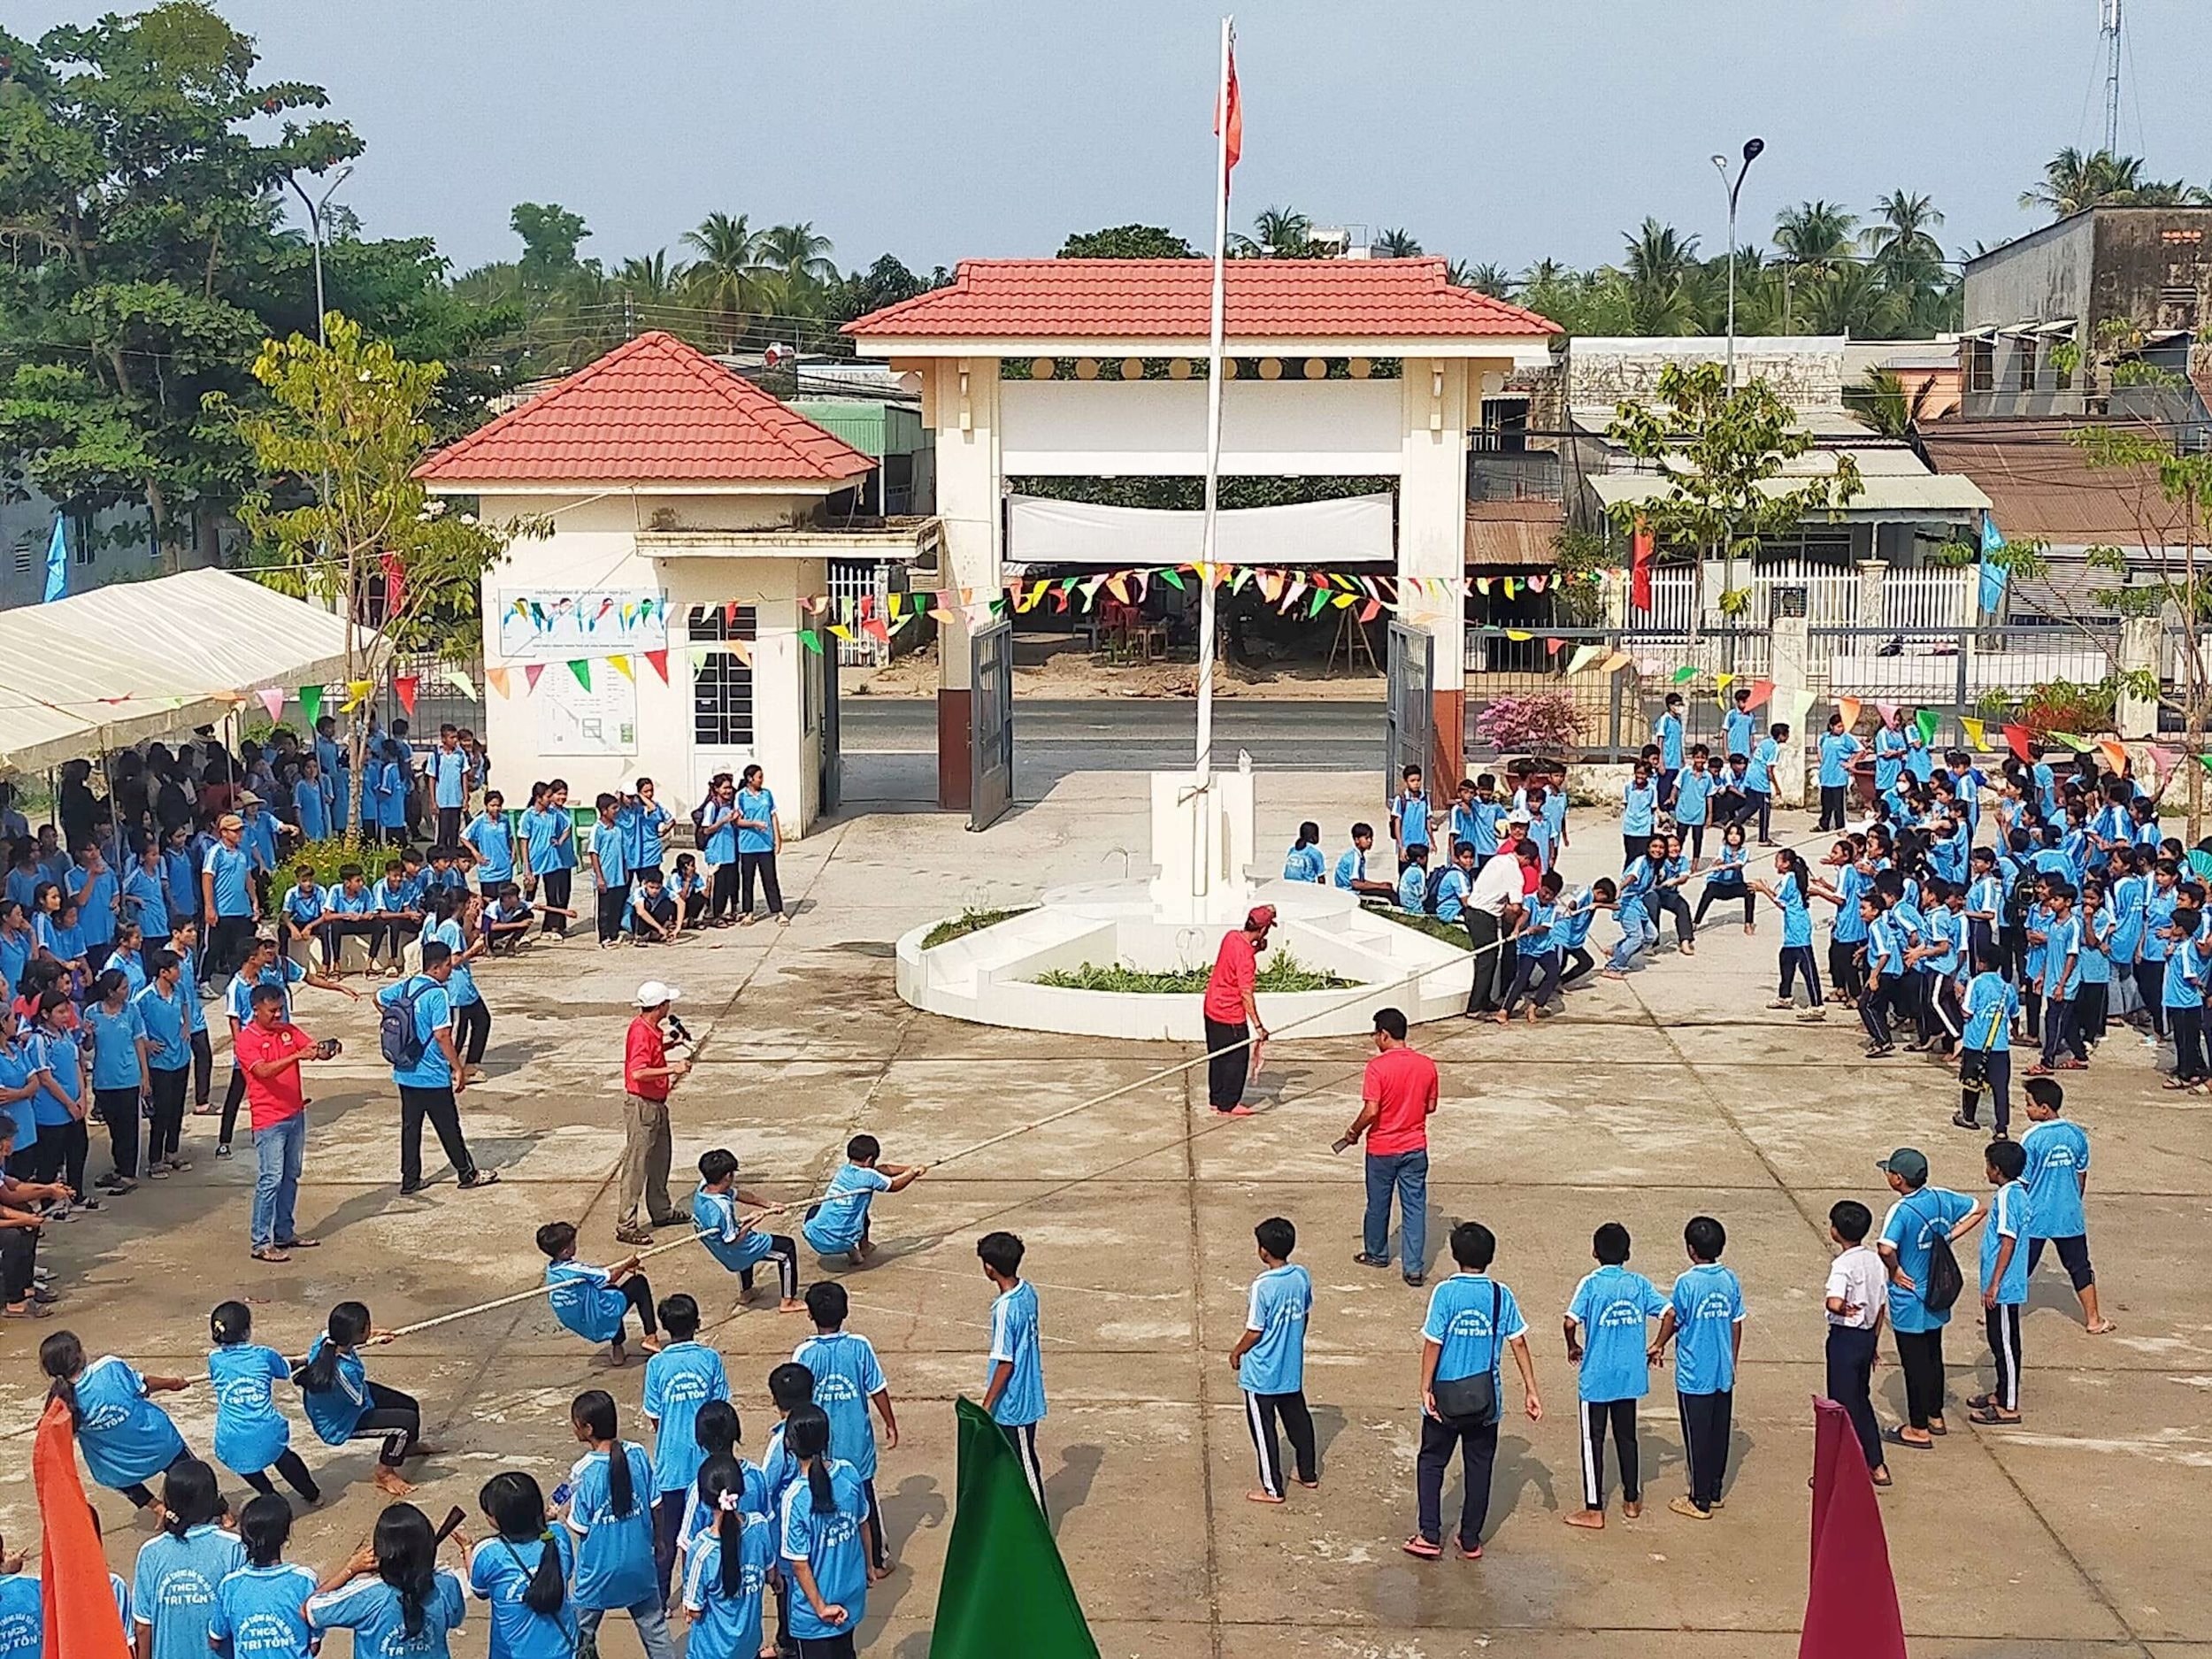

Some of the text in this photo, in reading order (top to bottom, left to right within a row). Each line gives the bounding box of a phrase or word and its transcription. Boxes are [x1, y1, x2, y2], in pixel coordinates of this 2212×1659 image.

[170, 1582, 199, 1593] THCS
[164, 1592, 209, 1606] TRI TÔN
[248, 1626, 279, 1638] THCS
[13, 1634, 38, 1648] TÔN
[241, 1636, 290, 1651] TRI TÔN
